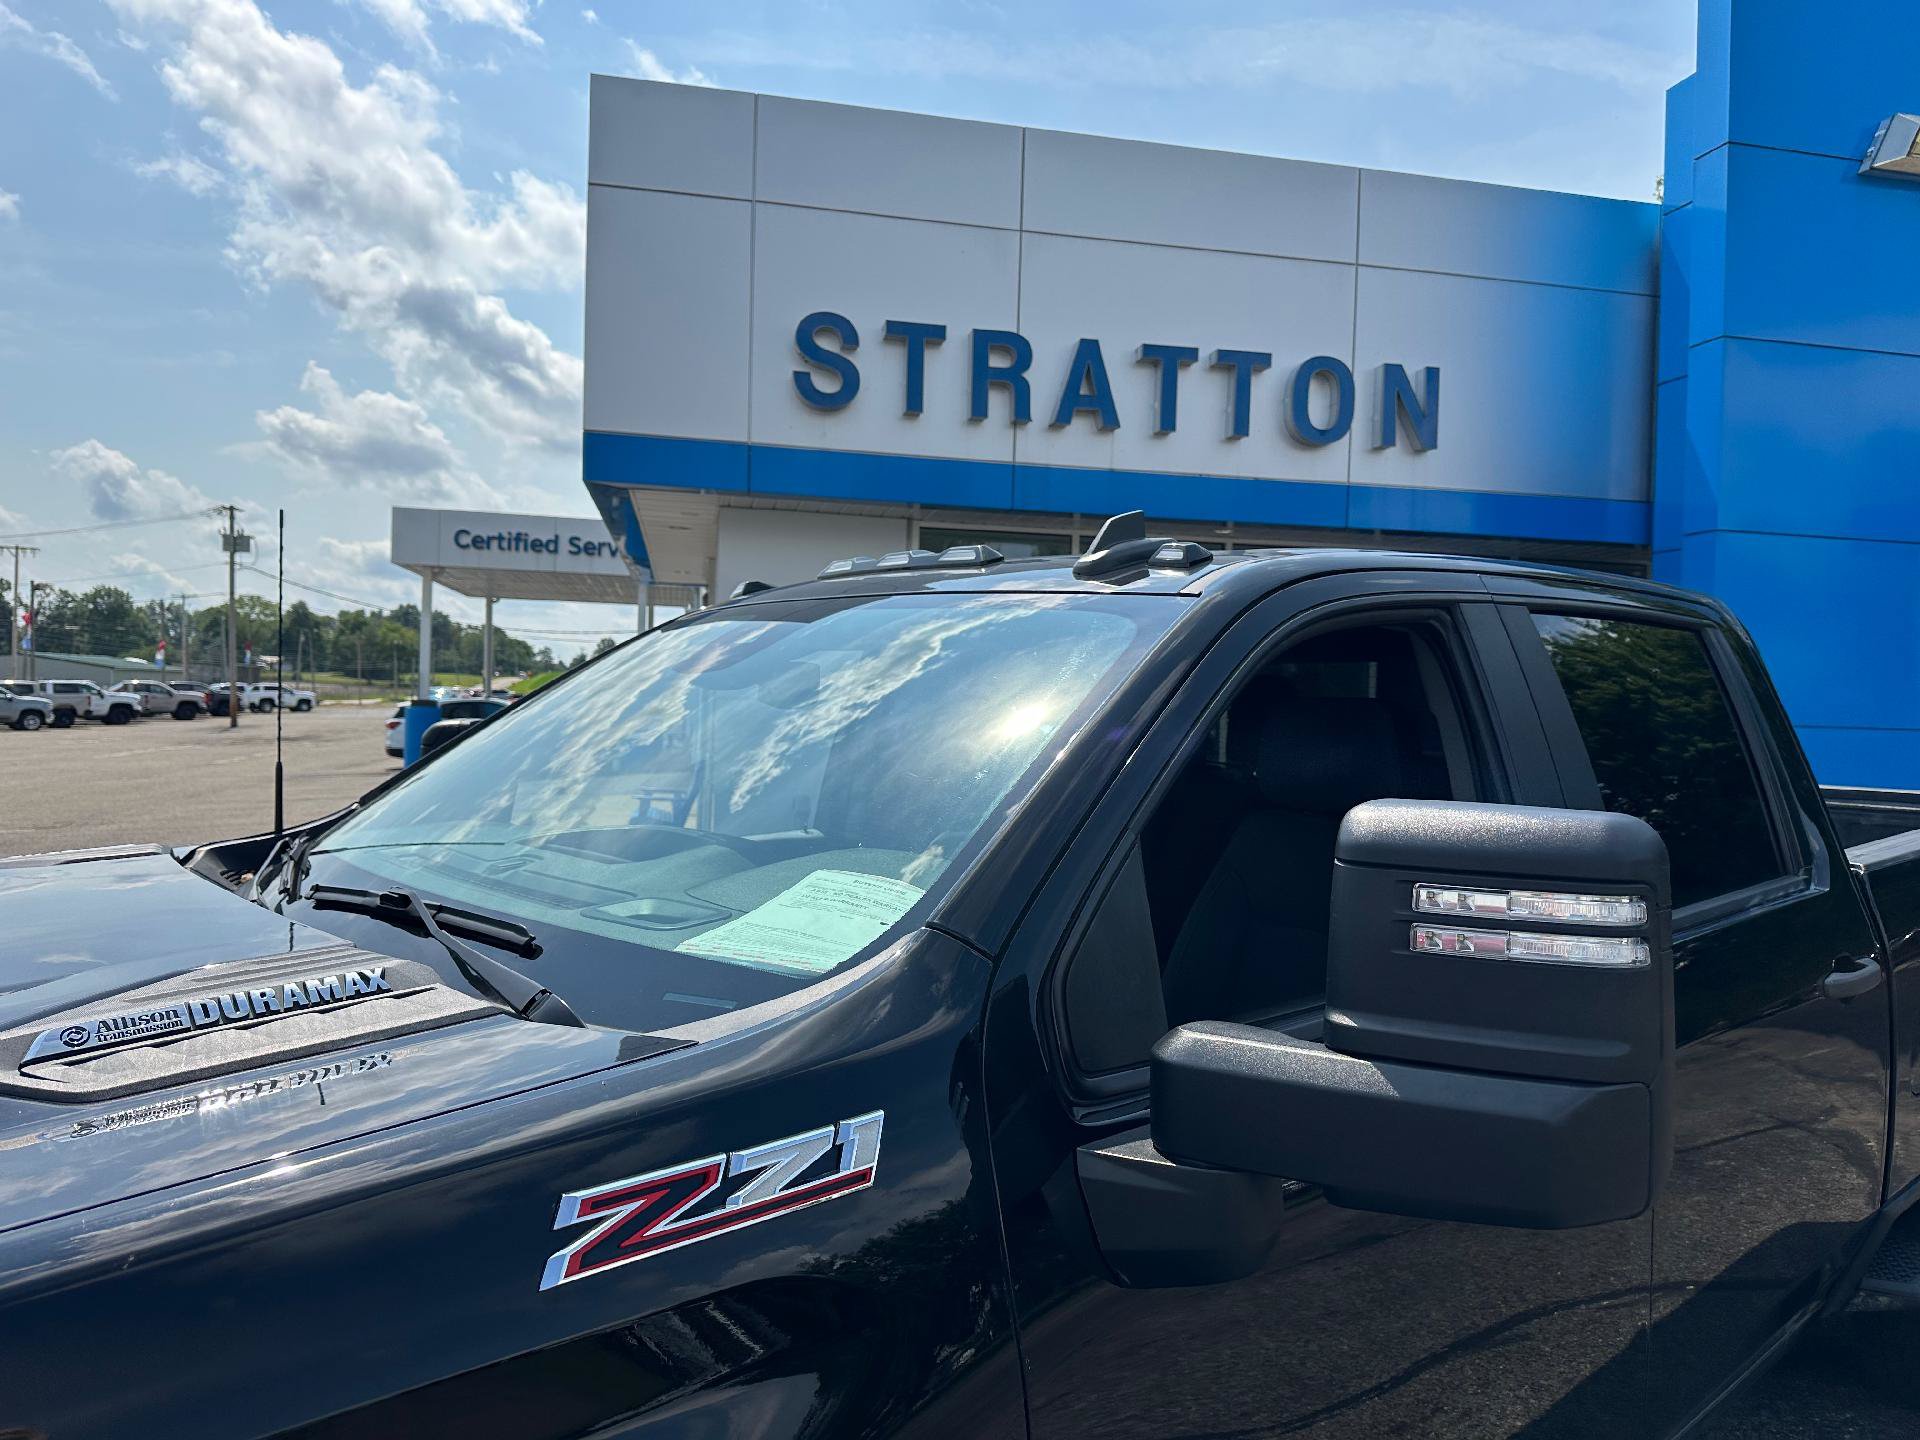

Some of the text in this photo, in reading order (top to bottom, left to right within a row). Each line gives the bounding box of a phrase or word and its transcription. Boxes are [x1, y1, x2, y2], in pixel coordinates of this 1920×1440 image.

[792, 310, 1441, 453] STRATTON
[453, 529, 560, 555] Certified
[188, 966, 393, 1027] DURAMAX
[94, 1009, 181, 1035] Allison
[94, 1018, 184, 1044] Transmission
[538, 1109, 885, 1292] Z71
